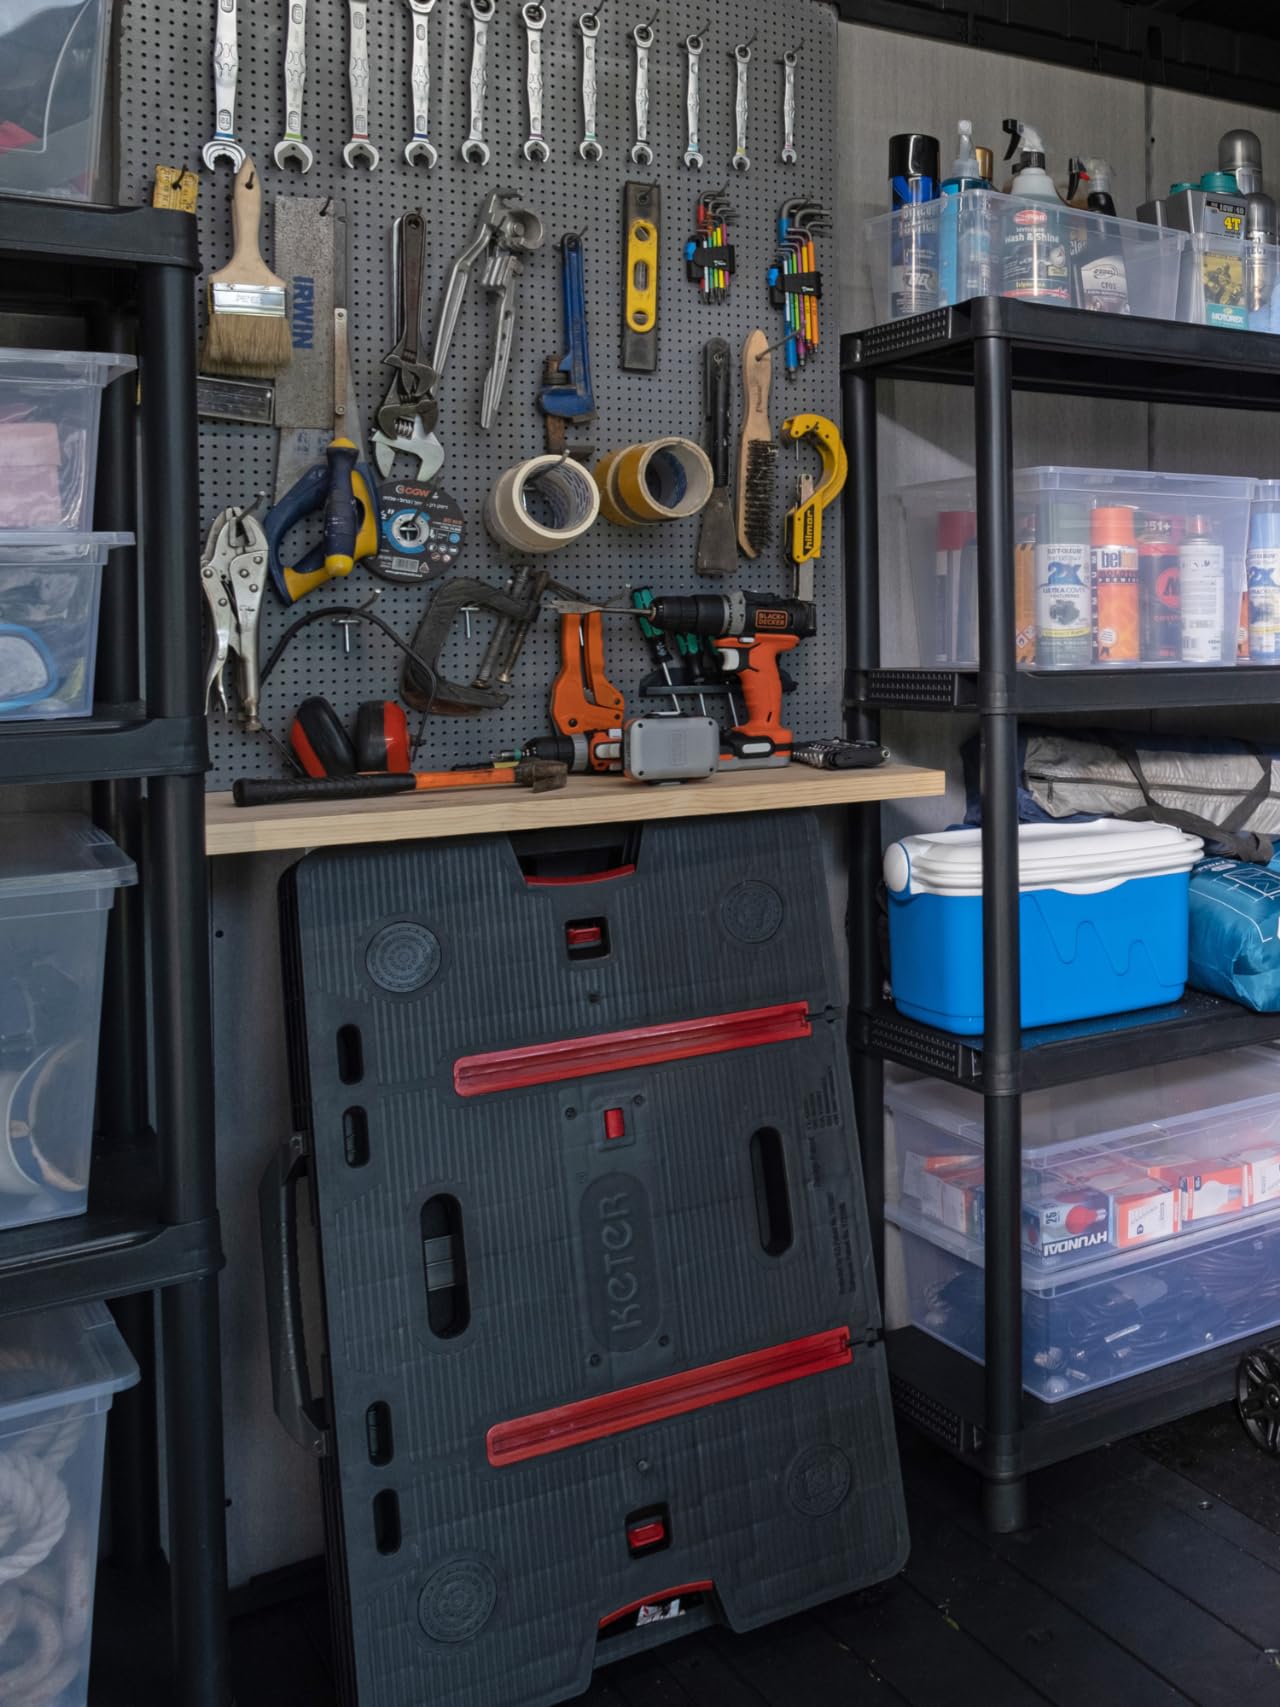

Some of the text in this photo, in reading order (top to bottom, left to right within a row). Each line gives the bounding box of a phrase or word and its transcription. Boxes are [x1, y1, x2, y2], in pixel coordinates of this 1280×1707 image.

[1224, 217, 1241, 231] 4T
[292, 275, 314, 349] IRWIN
[1211, 312, 1244, 324] MOTOREX
[1048, 561, 1082, 587] 2X
[1043, 1230, 1108, 1257] HYUNDAI
[602, 1192, 642, 1332] KETER
